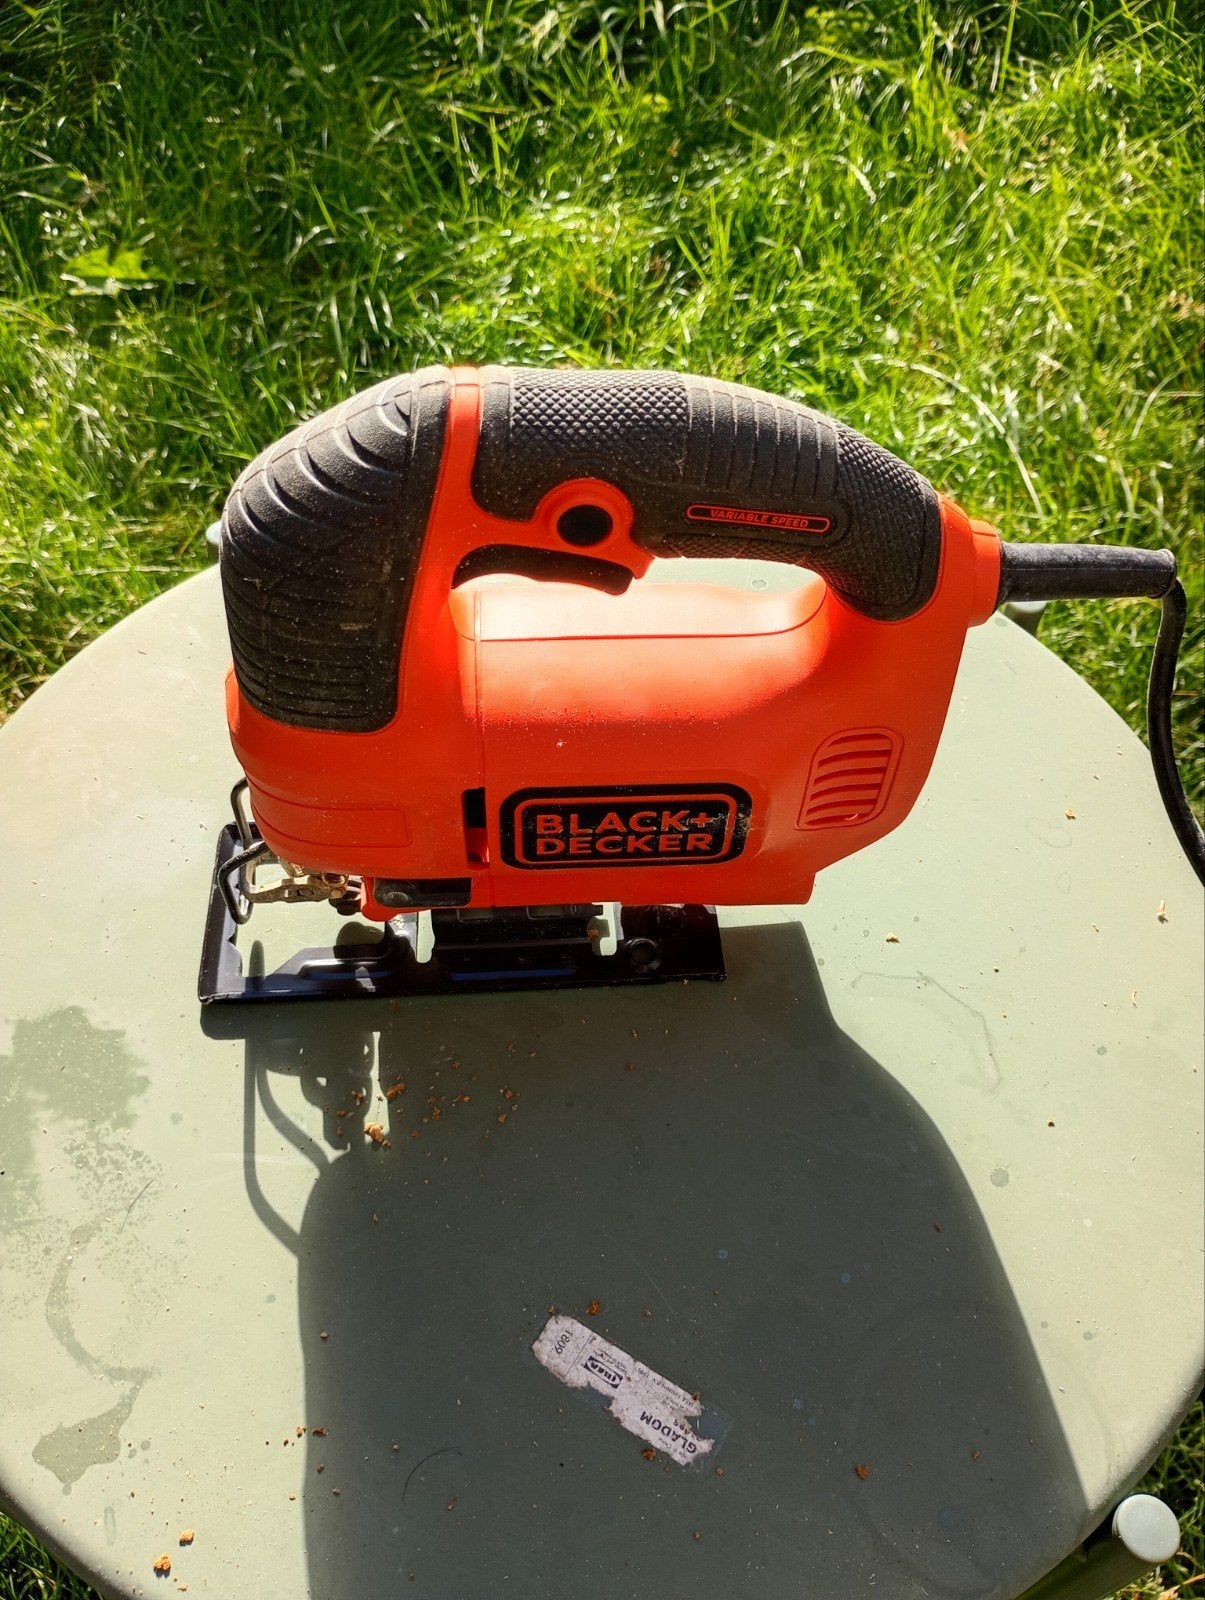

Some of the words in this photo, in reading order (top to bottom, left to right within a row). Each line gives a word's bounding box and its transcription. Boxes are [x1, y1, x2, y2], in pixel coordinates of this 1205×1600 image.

[710, 509, 769, 523] VARIABLE
[771, 516, 809, 528] SPEED
[536, 810, 715, 835] BLACK+
[536, 833, 714, 855] DECKER
[639, 1410, 698, 1454] GLADOM
